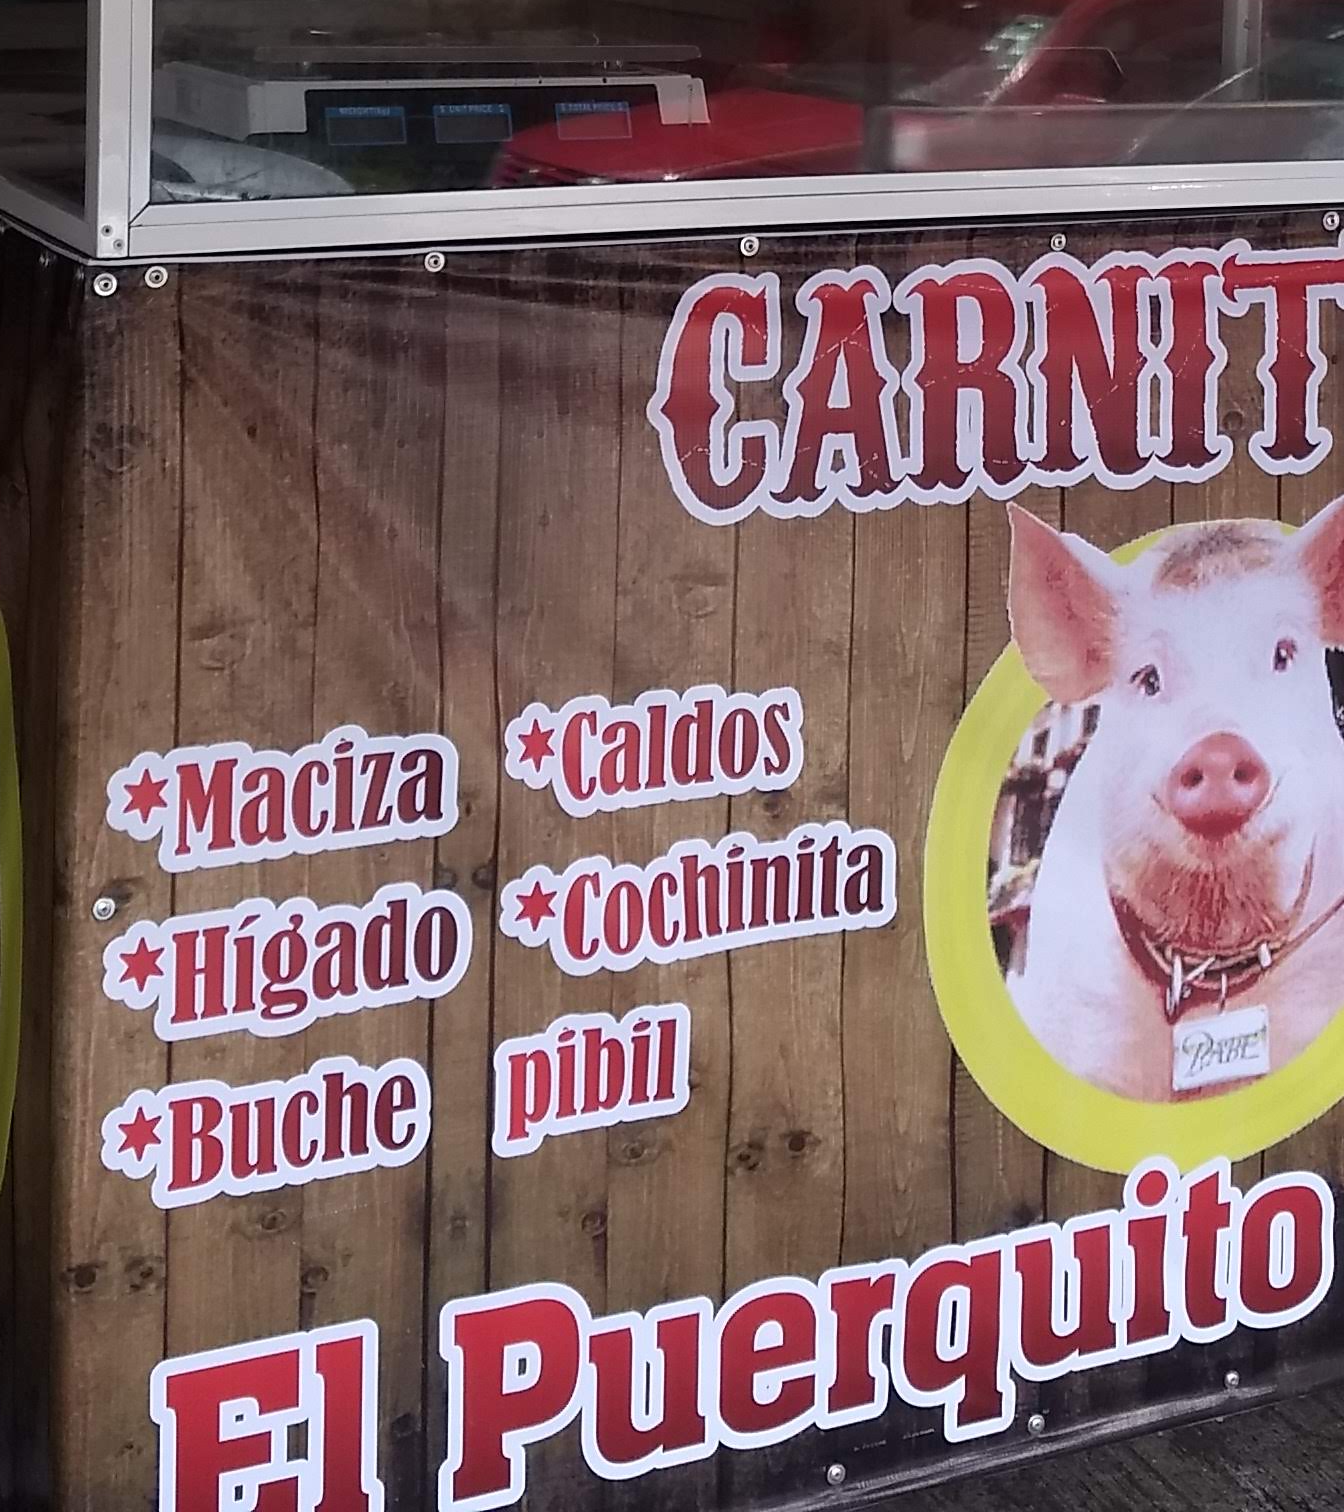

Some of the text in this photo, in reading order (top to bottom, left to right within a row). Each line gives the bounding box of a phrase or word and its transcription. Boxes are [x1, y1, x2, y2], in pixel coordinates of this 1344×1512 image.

[173, 737, 446, 857] Maciza
[561, 695, 794, 803] Caldos
[563, 833, 887, 963] Cochinita
[167, 897, 453, 1026] Hígado
[165, 1070, 420, 1194] Buche
[507, 1017, 680, 1143] pibil
[164, 1333, 370, 1512] El
[451, 1170, 1325, 1505] Puerquito
